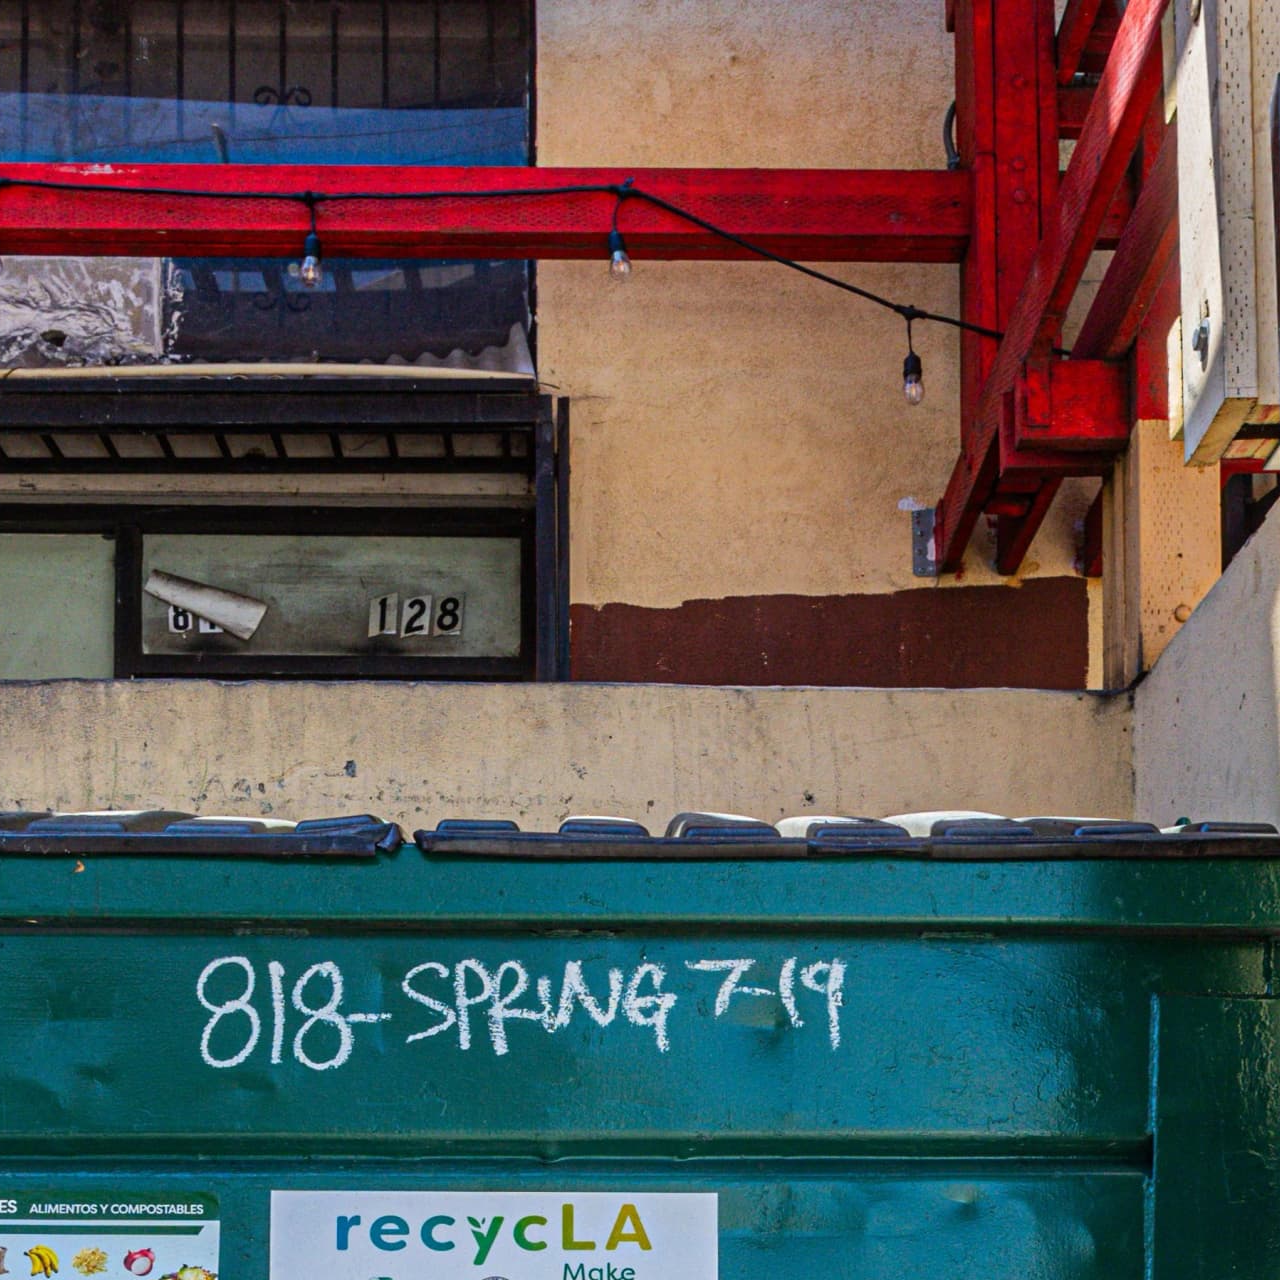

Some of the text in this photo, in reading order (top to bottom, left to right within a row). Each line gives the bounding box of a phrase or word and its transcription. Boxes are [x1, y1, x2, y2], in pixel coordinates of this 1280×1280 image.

[377, 596, 460, 635] 128
[685, 956, 847, 1050] 7-19
[29, 1204, 204, 1215] ALIMENTOS Y COMPOSTABLES
[336, 1203, 653, 1266] recycLA
